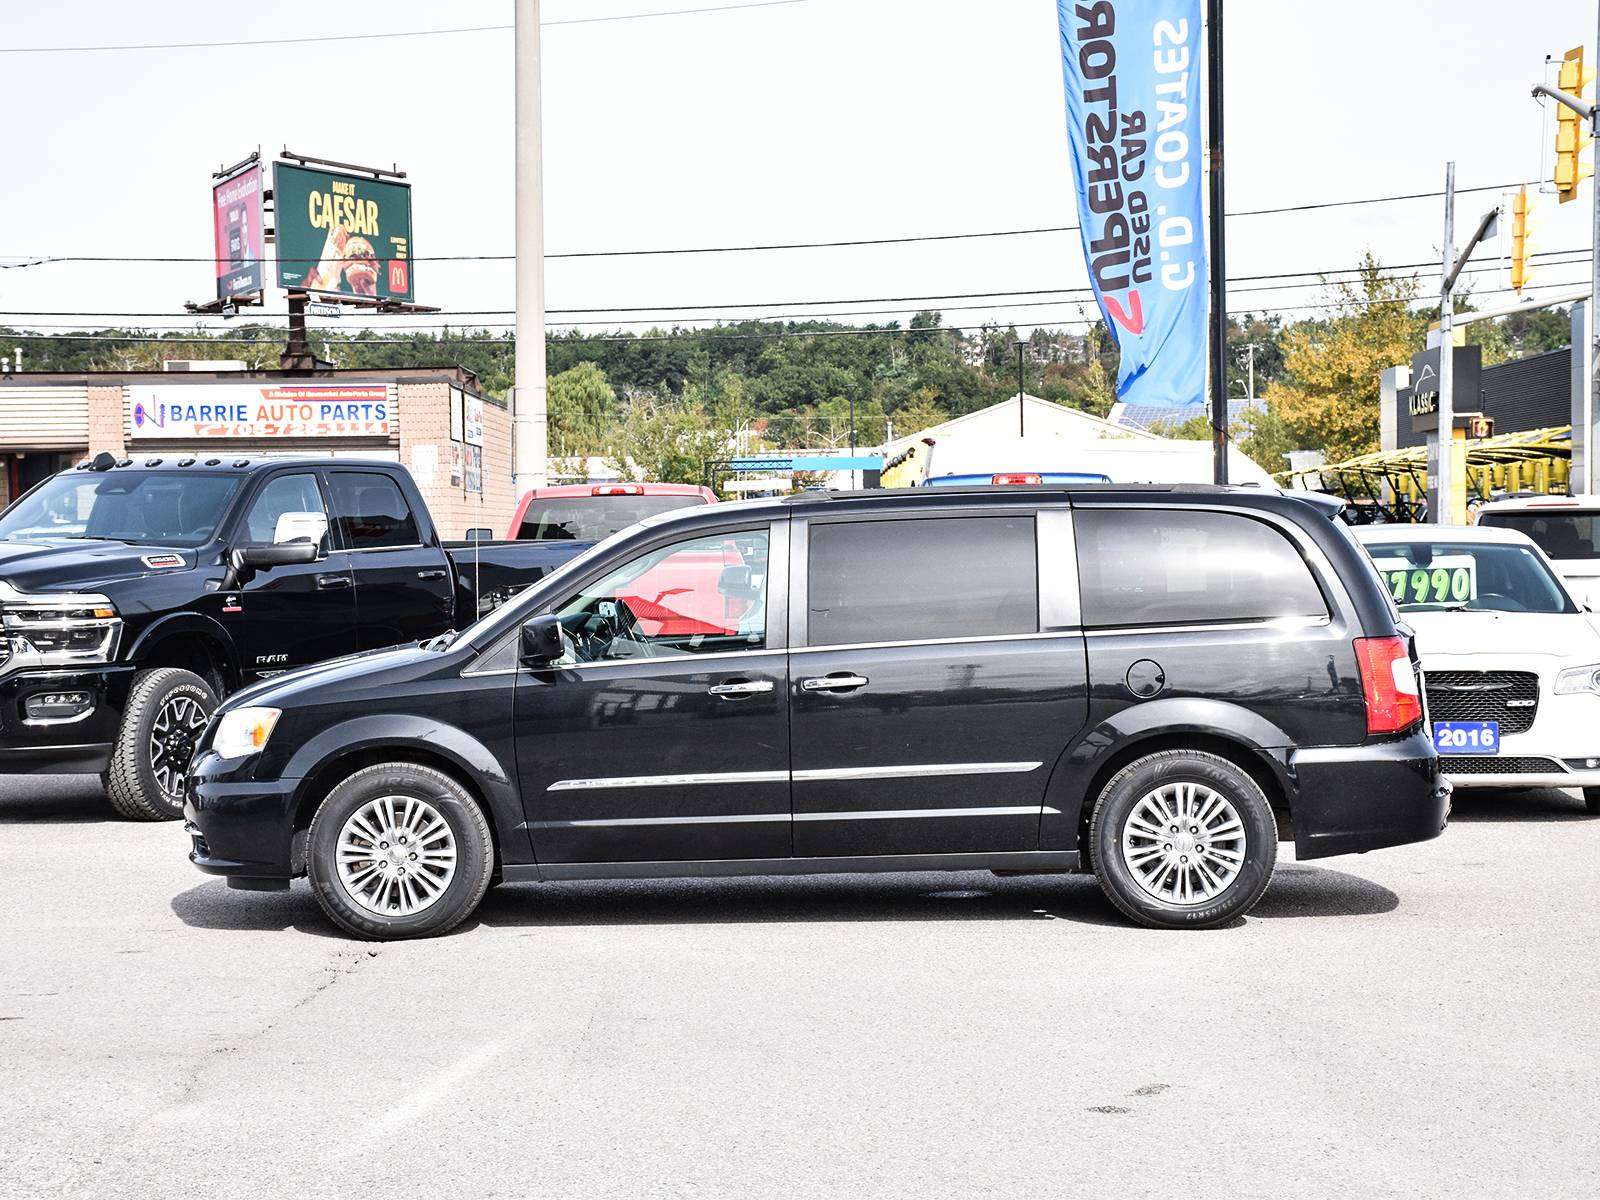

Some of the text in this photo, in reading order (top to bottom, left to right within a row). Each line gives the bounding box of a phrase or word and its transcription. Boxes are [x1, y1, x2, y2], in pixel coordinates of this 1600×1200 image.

[308, 190, 379, 236] CAESAR
[170, 403, 386, 422] BARRIE AUTO PARTS
[256, 654, 288, 664] RAM
[1438, 728, 1495, 747] 2016
